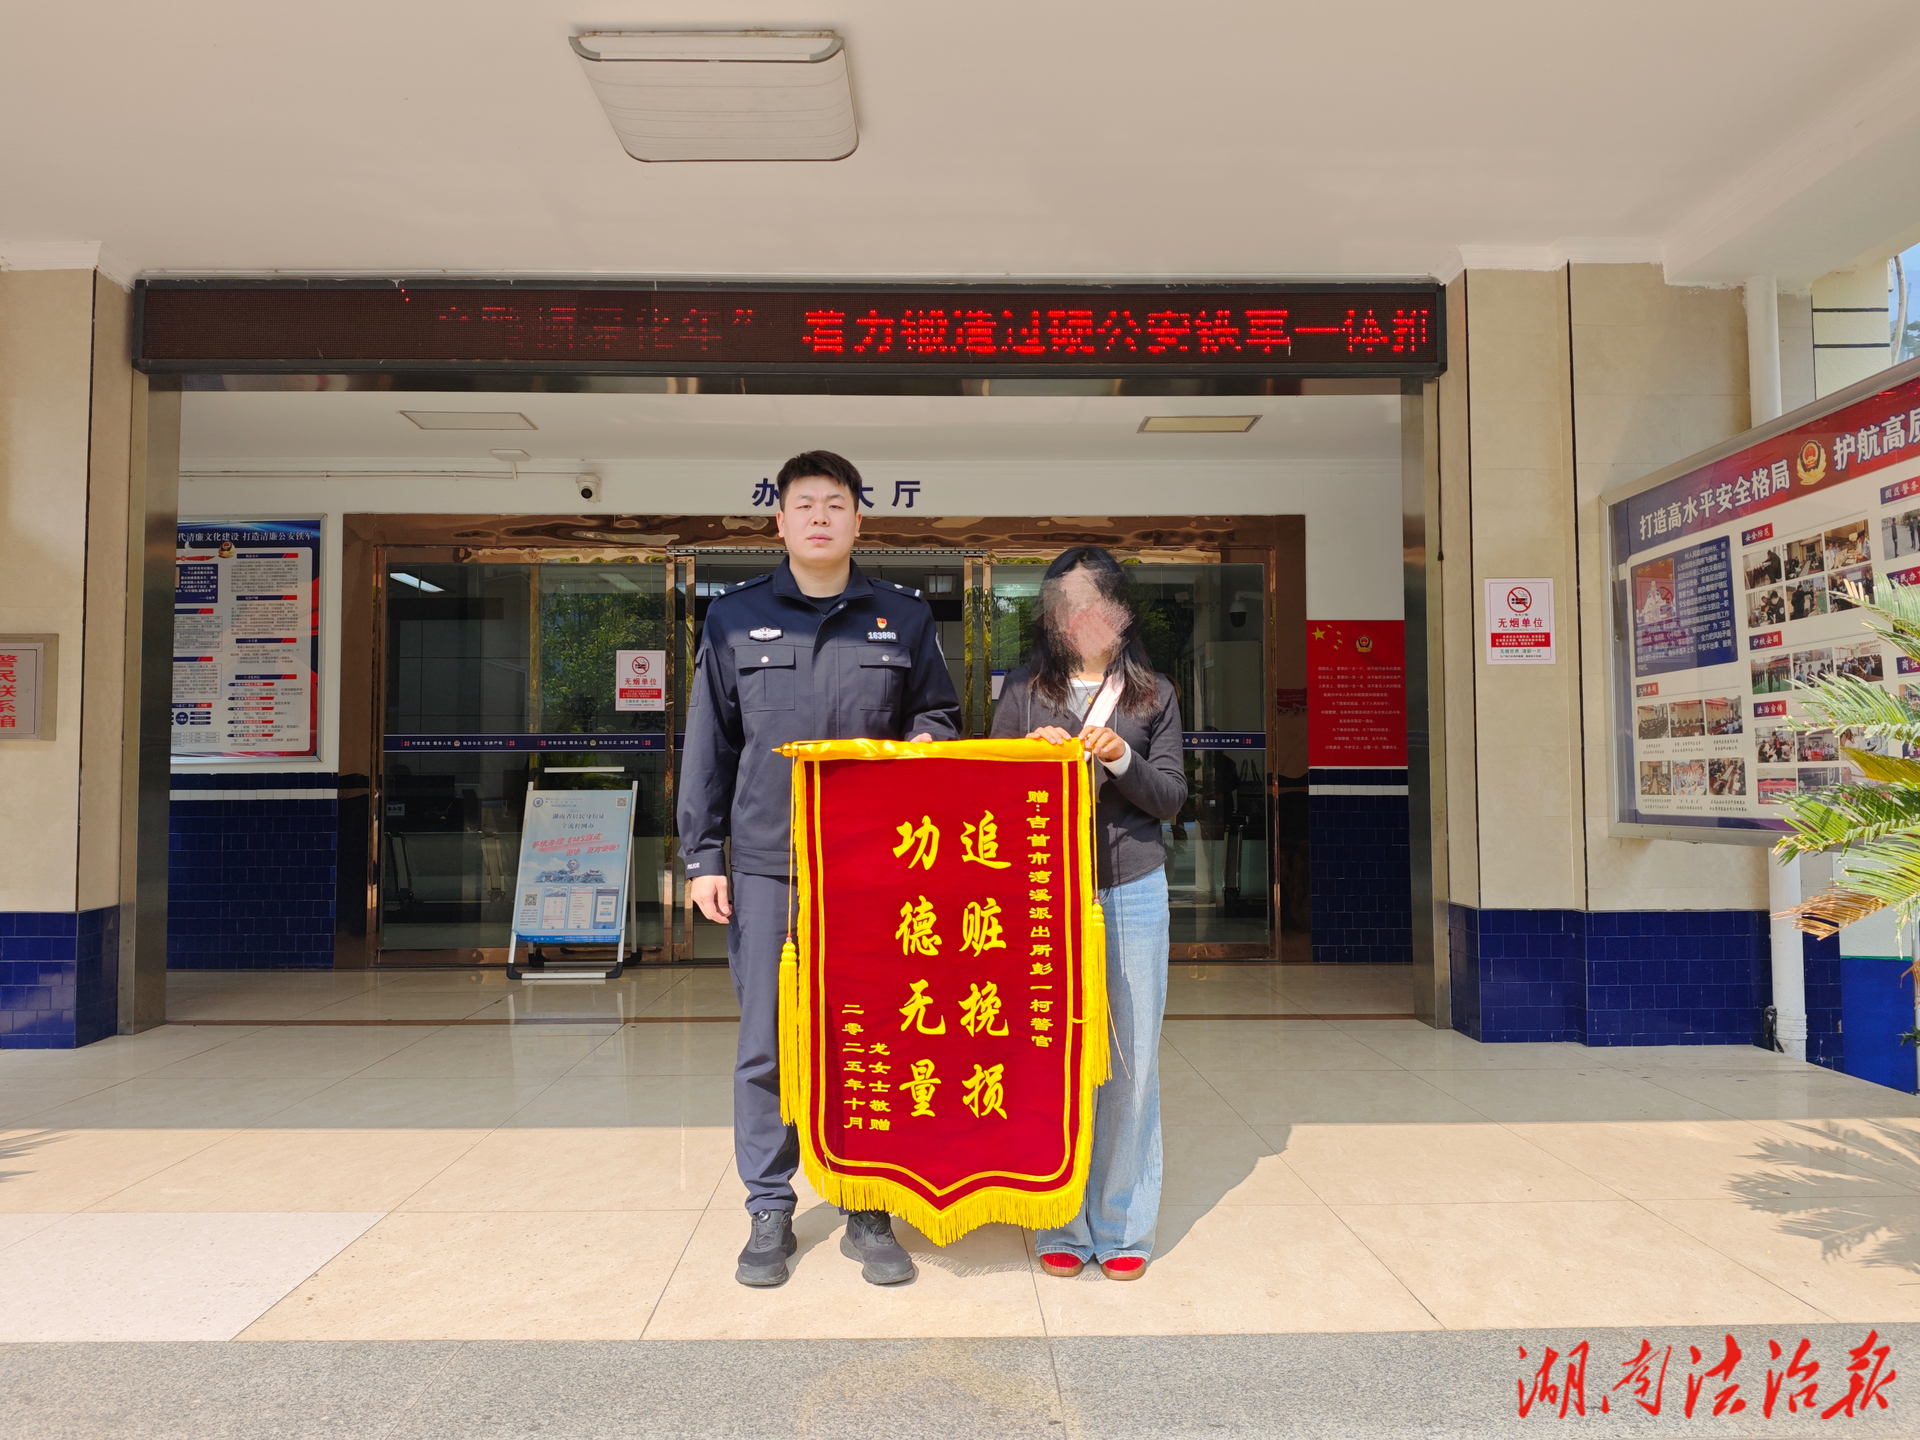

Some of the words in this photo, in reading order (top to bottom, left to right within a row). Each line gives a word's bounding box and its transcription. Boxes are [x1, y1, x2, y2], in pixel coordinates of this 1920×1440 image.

[242, 531, 313, 541] 打造清廉公安铁军
[1639, 459, 1791, 541] 打造高水平安全格局
[1744, 527, 1770, 543] 安全防范
[1498, 618, 1543, 628] 无烟单位
[625, 677, 657, 685] 无烟单位
[893, 815, 946, 1117] 功德无量
[958, 810, 1011, 1120] 追赃挽损
[841, 1004, 866, 1130] 二零二五年十月
[868, 1042, 891, 1131] 龙女士敬赠
